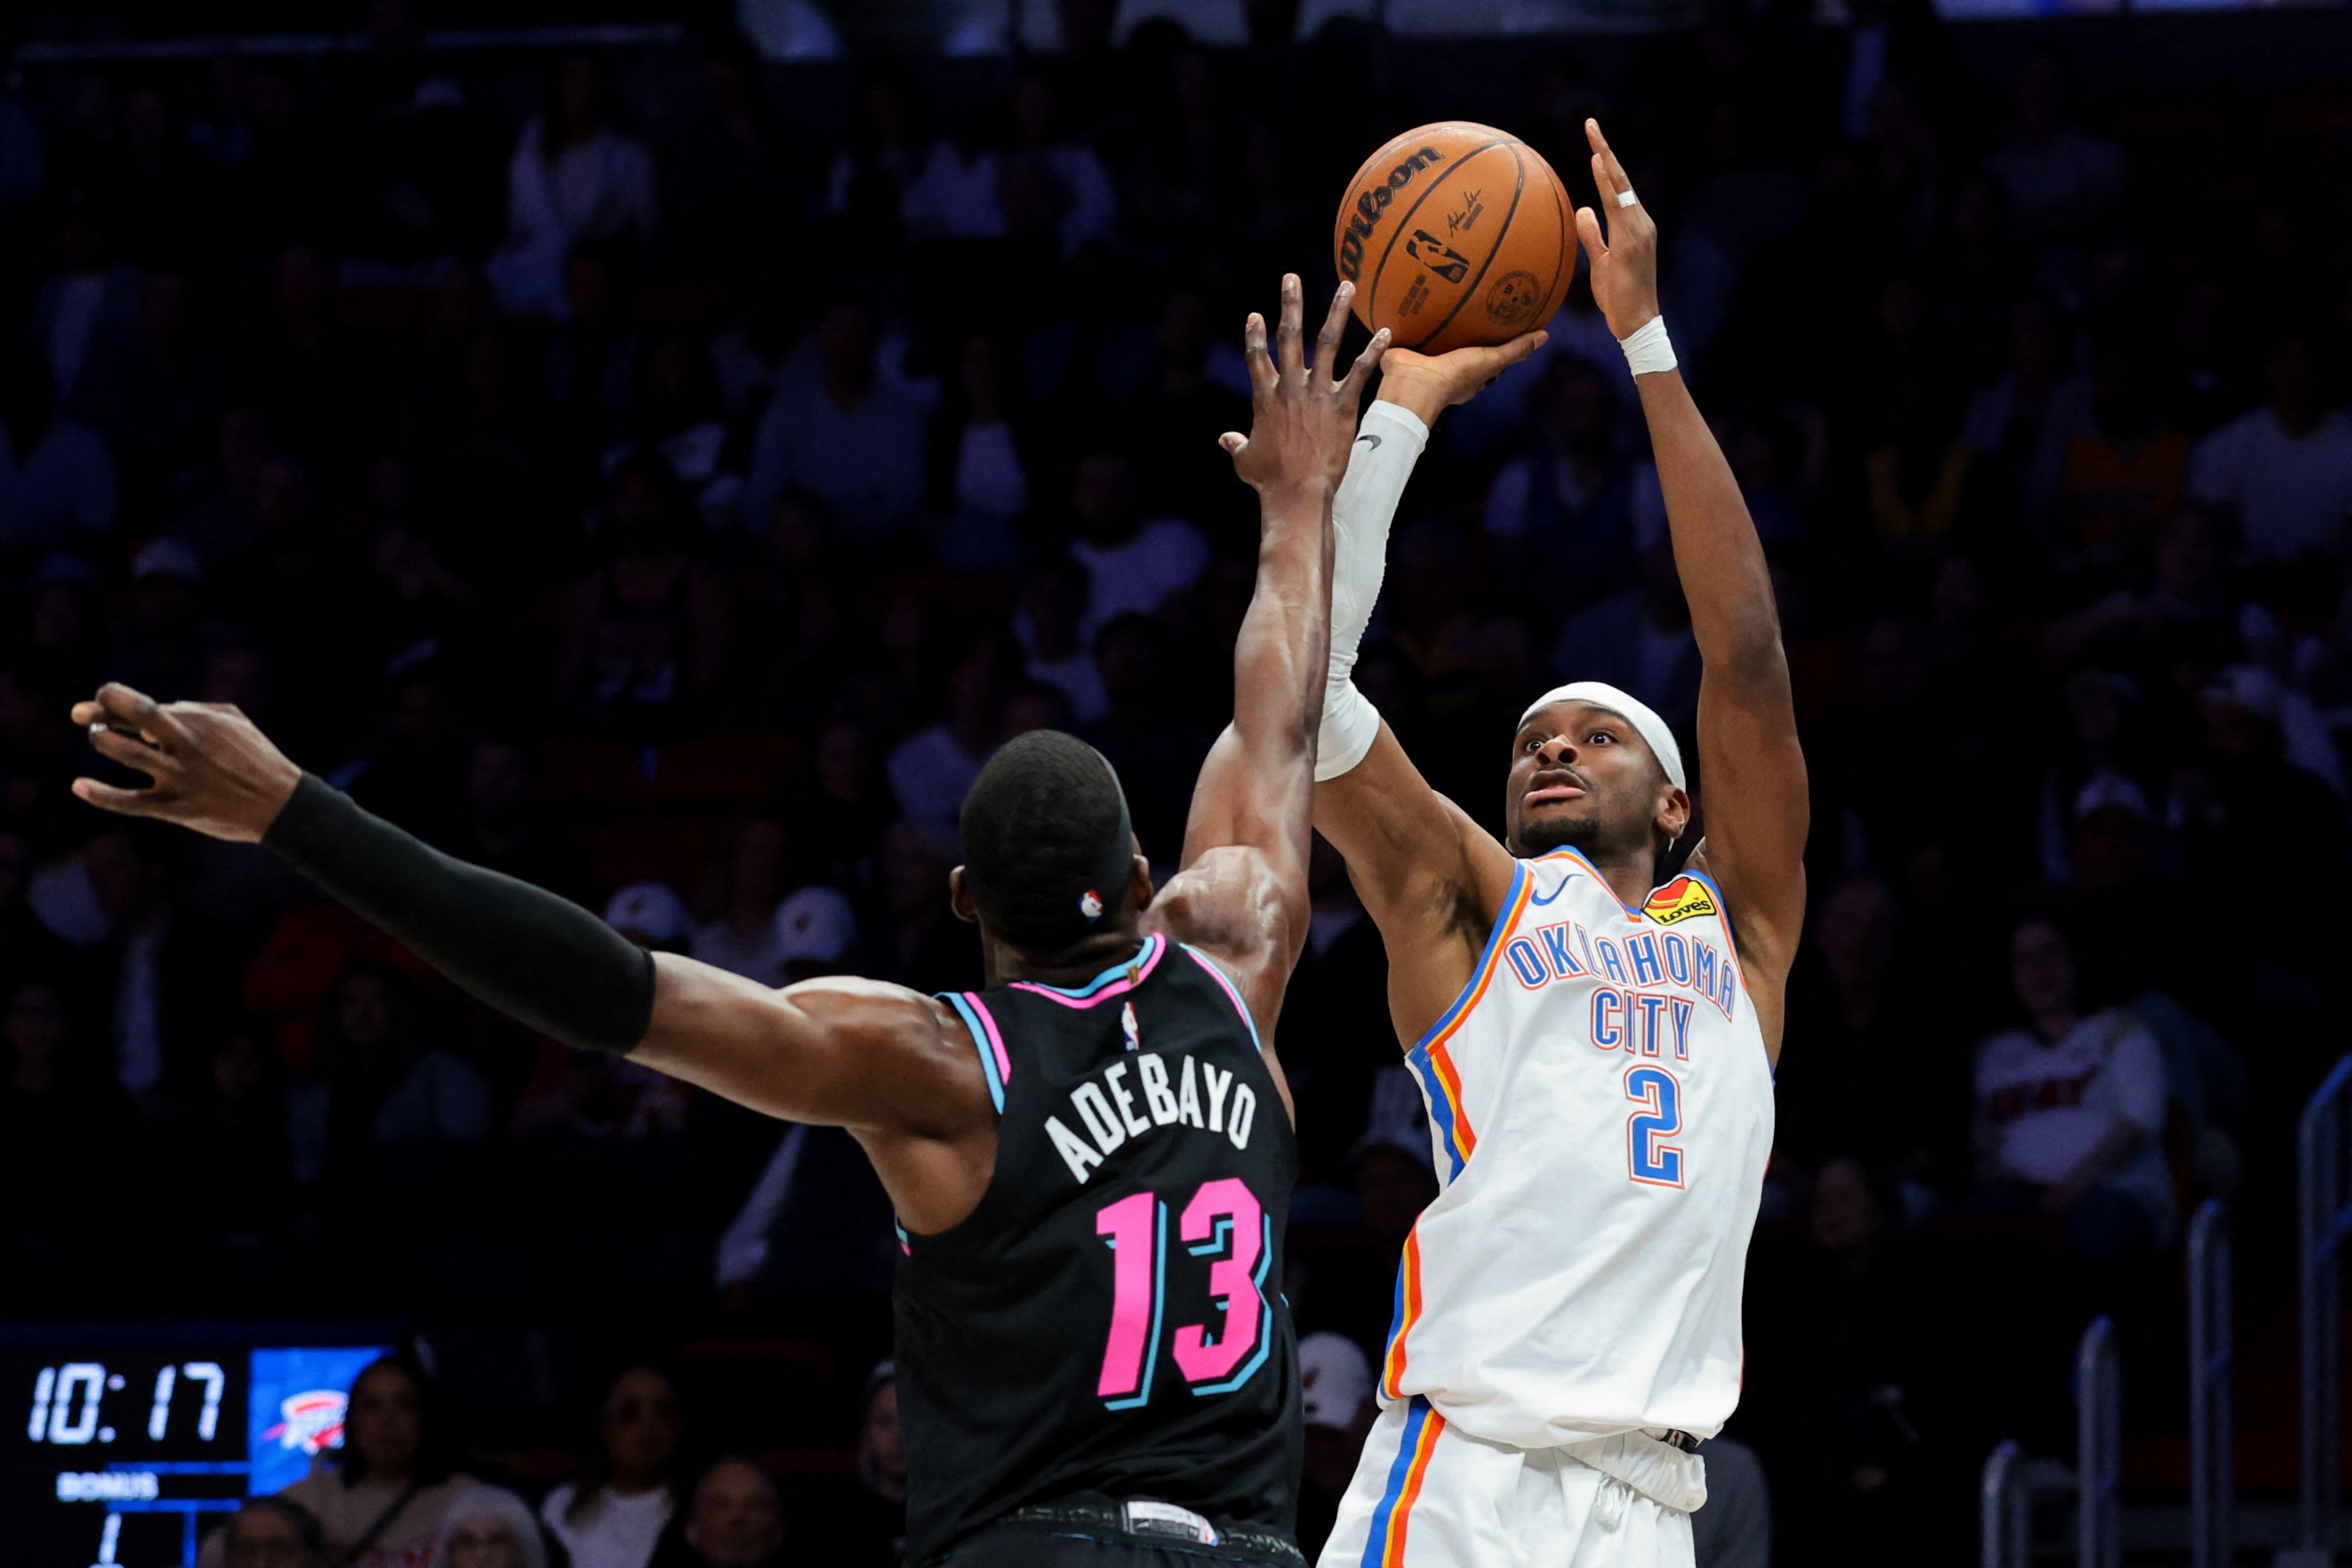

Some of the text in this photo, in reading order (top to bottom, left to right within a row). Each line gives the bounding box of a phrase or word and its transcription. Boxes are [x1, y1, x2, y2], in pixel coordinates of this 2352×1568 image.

[1340, 146, 1446, 281] Wilson
[1504, 921, 1736, 1022] OKLAHOMA
[1590, 987, 1695, 1061] CITY
[1044, 1053, 1257, 1184] ADEBAYO
[1623, 1065, 1685, 1190] 2
[1096, 1177, 1273, 1411] 13
[27, 1362, 226, 1444] 10:17
[56, 1471, 159, 1501] BONUS
